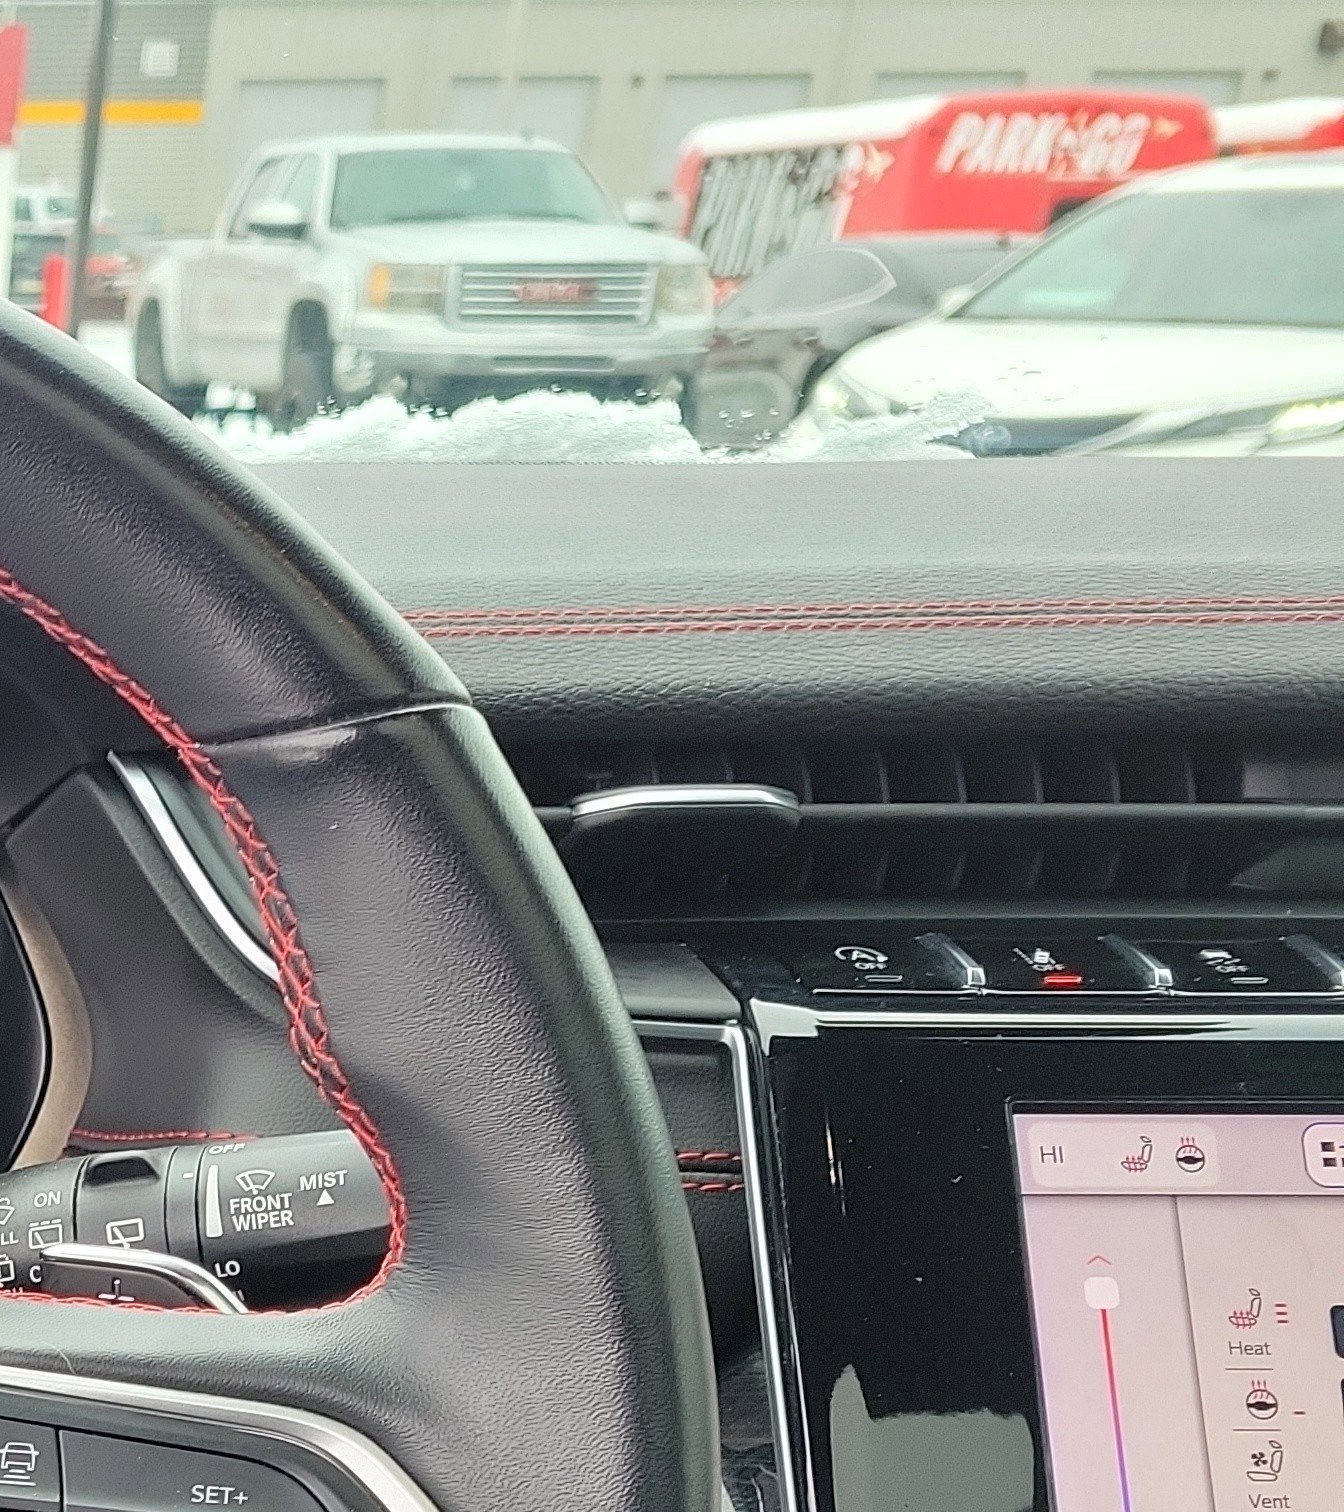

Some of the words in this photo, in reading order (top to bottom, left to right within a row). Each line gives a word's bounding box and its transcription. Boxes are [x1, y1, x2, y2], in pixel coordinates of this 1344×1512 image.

[208, 1142, 246, 1155] OFF
[1040, 1146, 1064, 1164] HI
[299, 1169, 348, 1192] MIST
[33, 1191, 61, 1209] ON
[229, 1192, 293, 1215] FRONT
[231, 1209, 295, 1232] WIPER
[214, 1260, 241, 1278] LO
[1228, 1340, 1272, 1356] Heat
[190, 1485, 249, 1505] SET+
[1248, 1494, 1291, 1509] Vent
